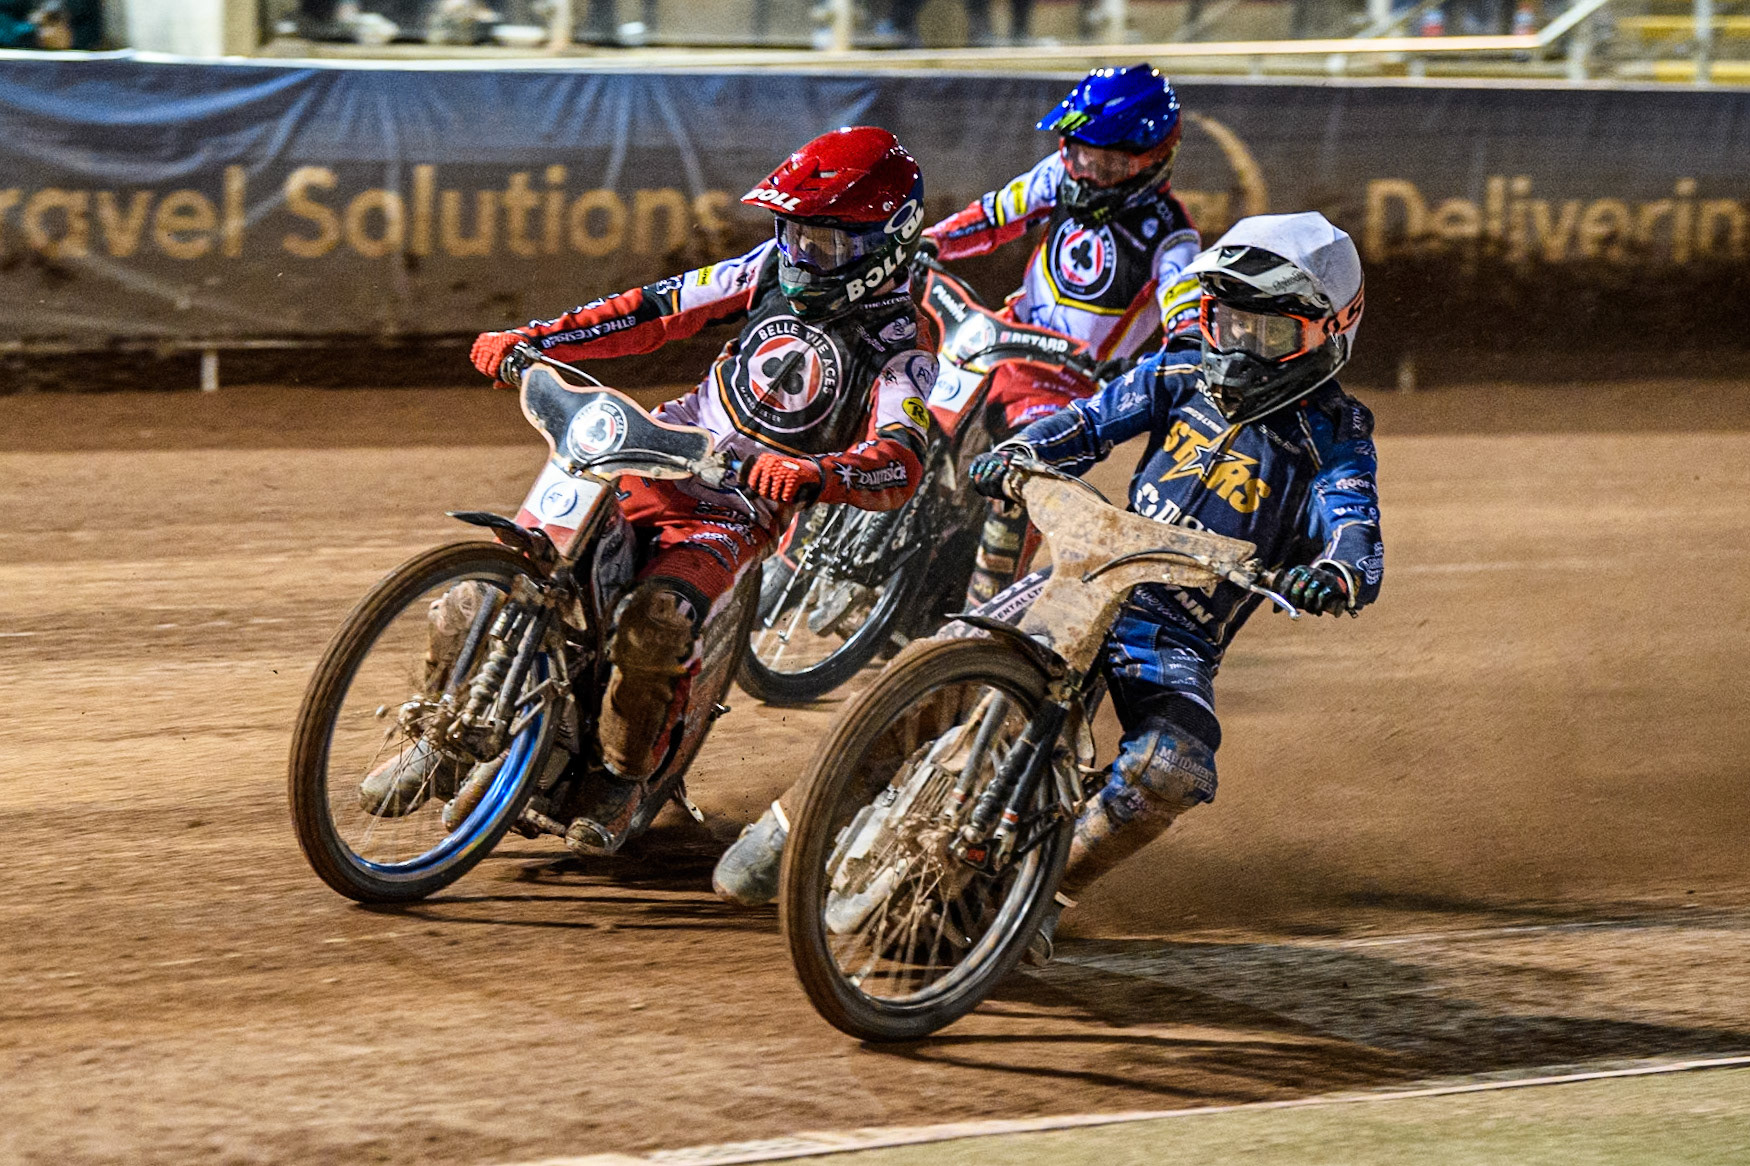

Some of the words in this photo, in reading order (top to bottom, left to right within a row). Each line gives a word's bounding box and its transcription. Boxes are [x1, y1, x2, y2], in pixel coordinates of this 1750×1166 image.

[283, 164, 732, 259] Solutions
[757, 322, 801, 342] BELLE
[805, 332, 829, 355] VUE
[821, 357, 836, 396] ACES
[993, 597, 1027, 620] ENTAL
